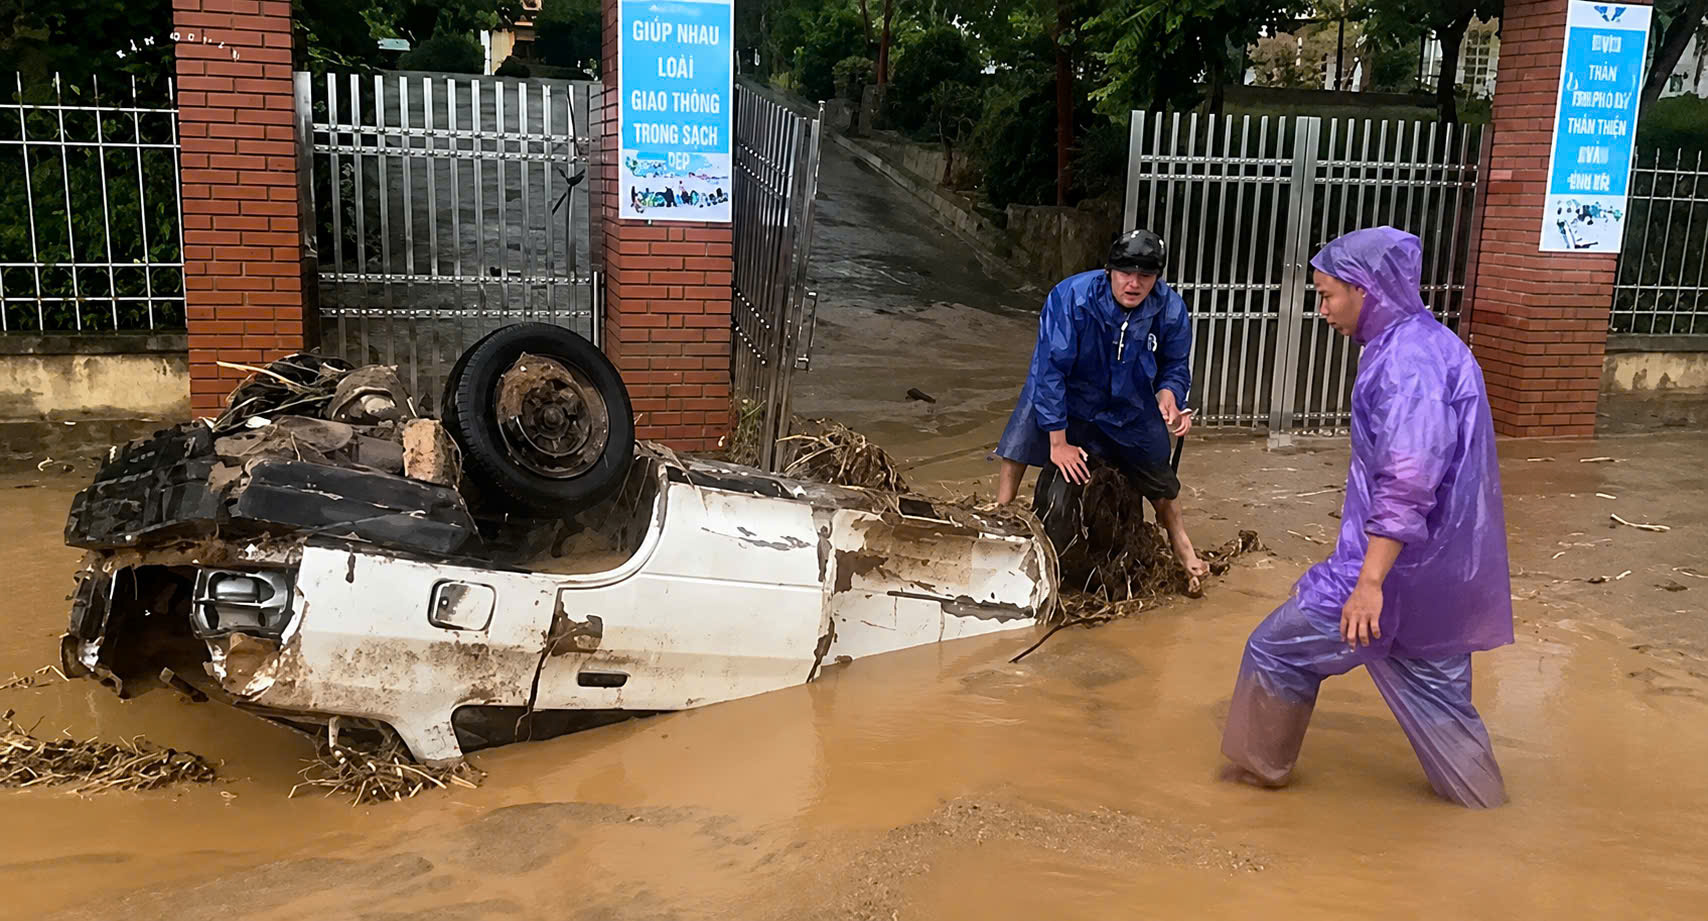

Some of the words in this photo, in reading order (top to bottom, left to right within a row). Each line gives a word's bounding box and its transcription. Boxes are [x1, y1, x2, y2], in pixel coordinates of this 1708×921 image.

[632, 15, 673, 42] GIÚP
[677, 23, 720, 45] NHAU
[631, 89, 668, 112] GIAO
[633, 122, 679, 144] TRONG
[682, 124, 718, 150] SẠCH
